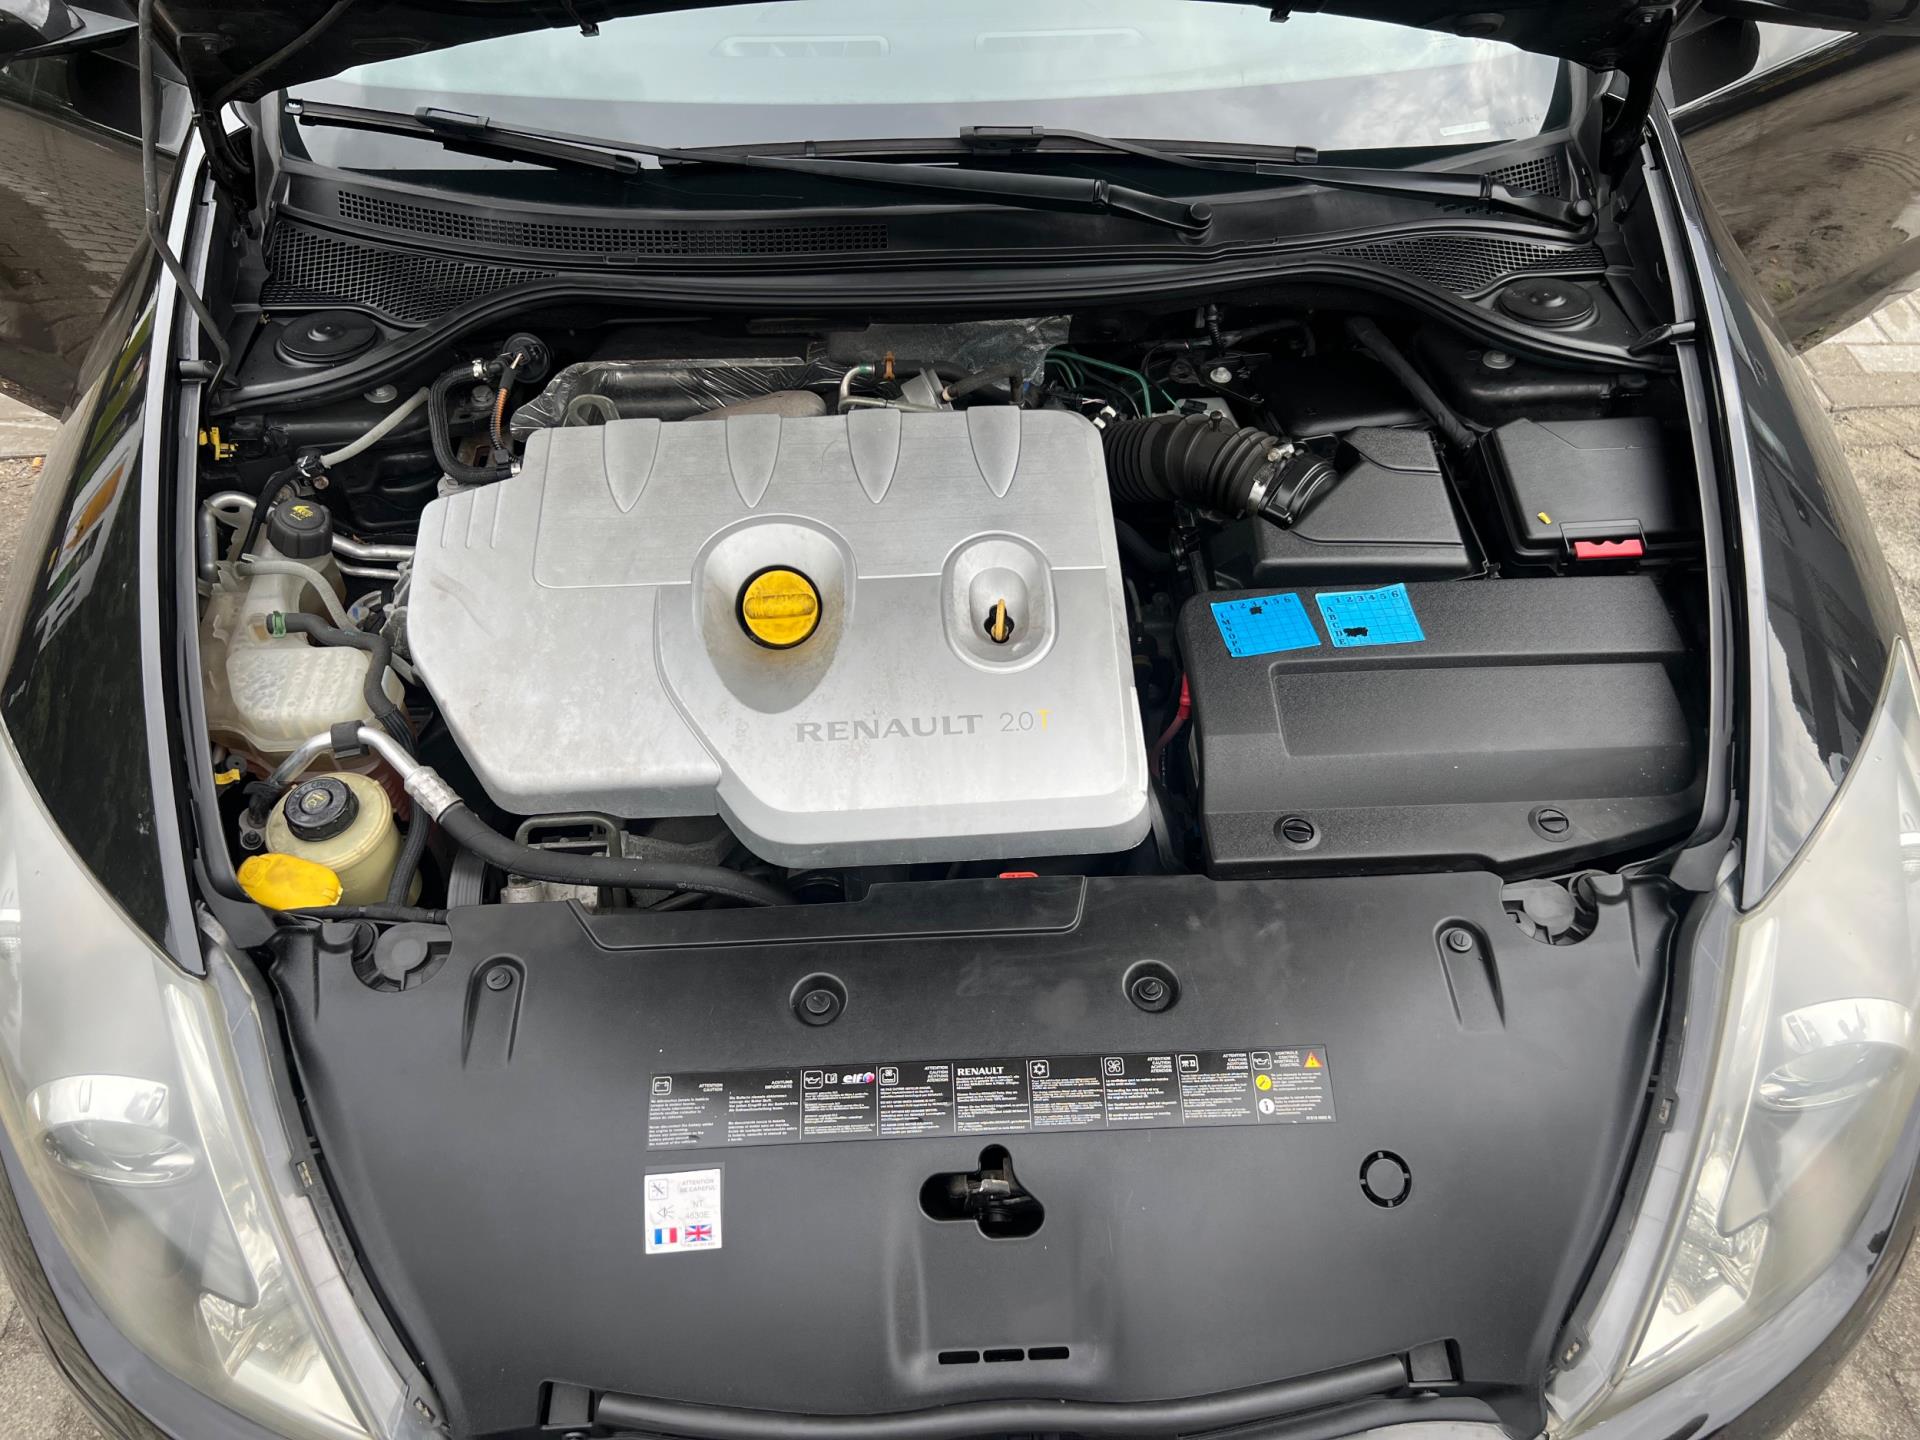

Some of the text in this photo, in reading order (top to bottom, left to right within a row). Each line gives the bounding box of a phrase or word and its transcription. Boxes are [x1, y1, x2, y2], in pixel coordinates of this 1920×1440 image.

[1346, 595, 1354, 603] 2
[1356, 594, 1365, 602] 3
[1367, 593, 1376, 601] 4
[1379, 592, 1387, 600] 5
[1391, 590, 1399, 599] 6
[1326, 605, 1334, 613] A
[796, 714, 984, 743] RENAULT
[957, 1066, 1004, 1076] RENAULT
[842, 1073, 864, 1083] elf
